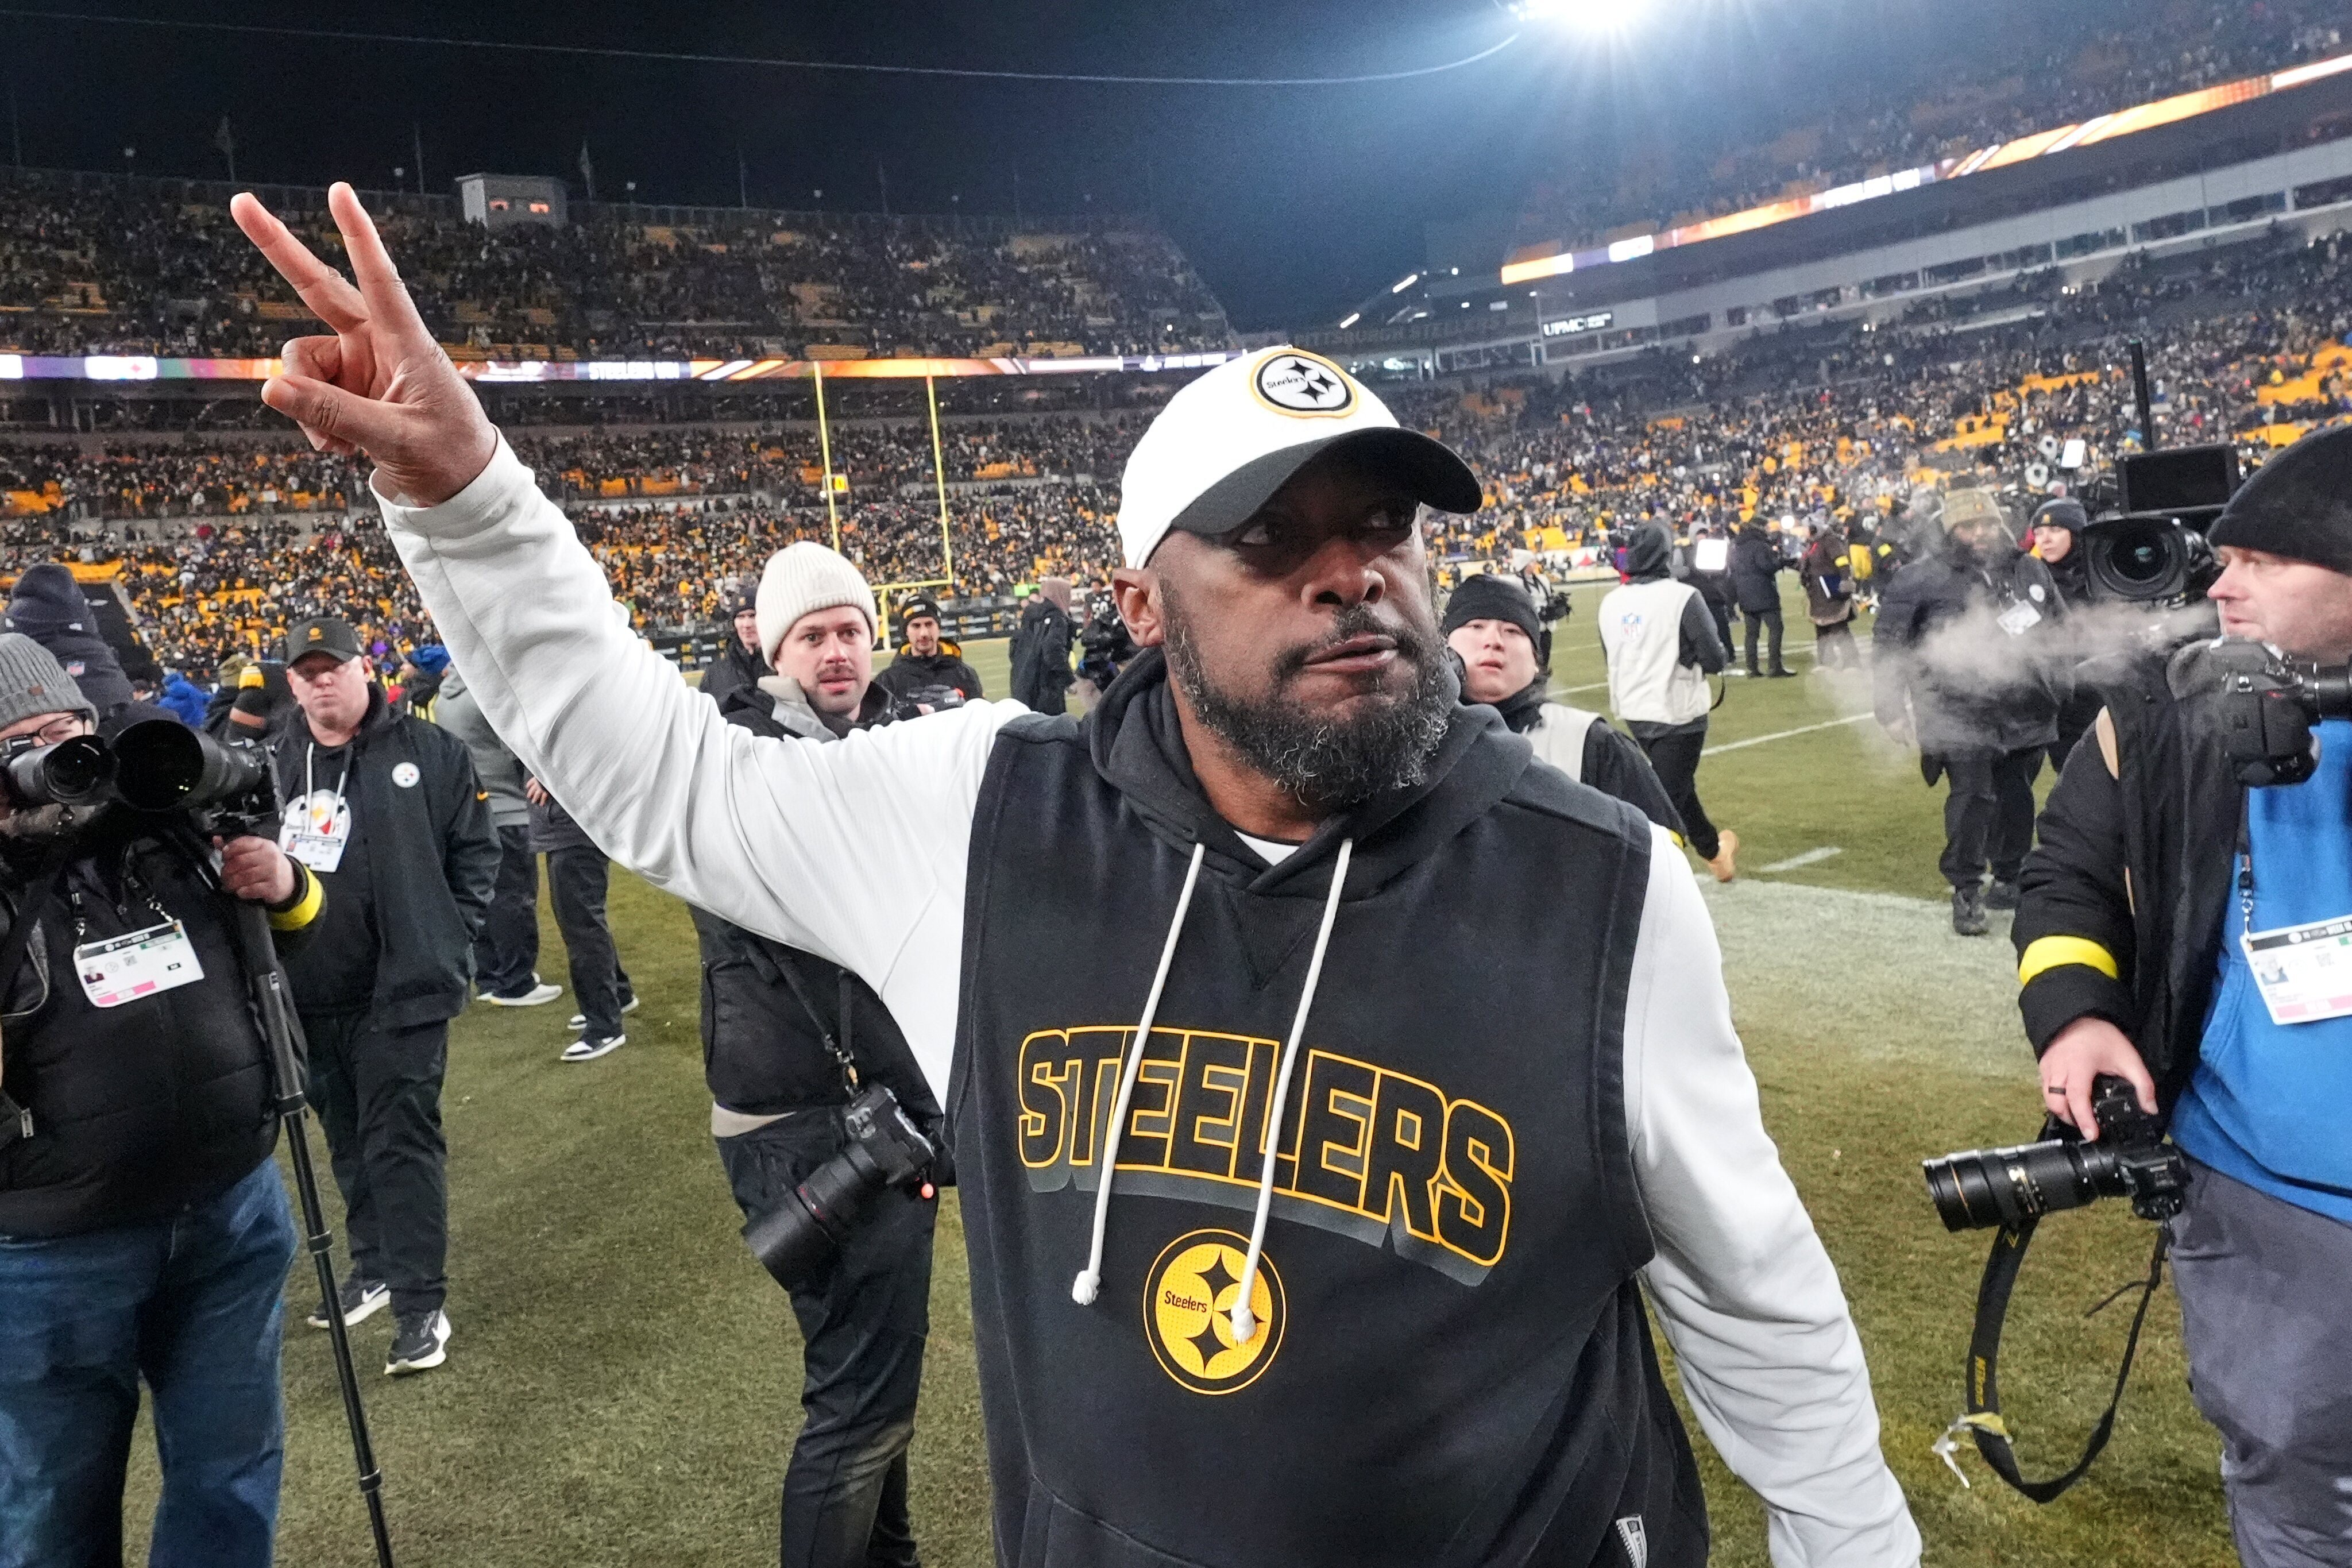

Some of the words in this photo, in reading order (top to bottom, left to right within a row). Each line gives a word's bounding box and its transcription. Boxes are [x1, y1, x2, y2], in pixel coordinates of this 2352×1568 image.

[1543, 317, 1585, 337] UPMC
[1266, 376, 1307, 389] Steelers
[1018, 1025, 1515, 1268] STEELERS
[1164, 1289, 1208, 1314] Steelers
